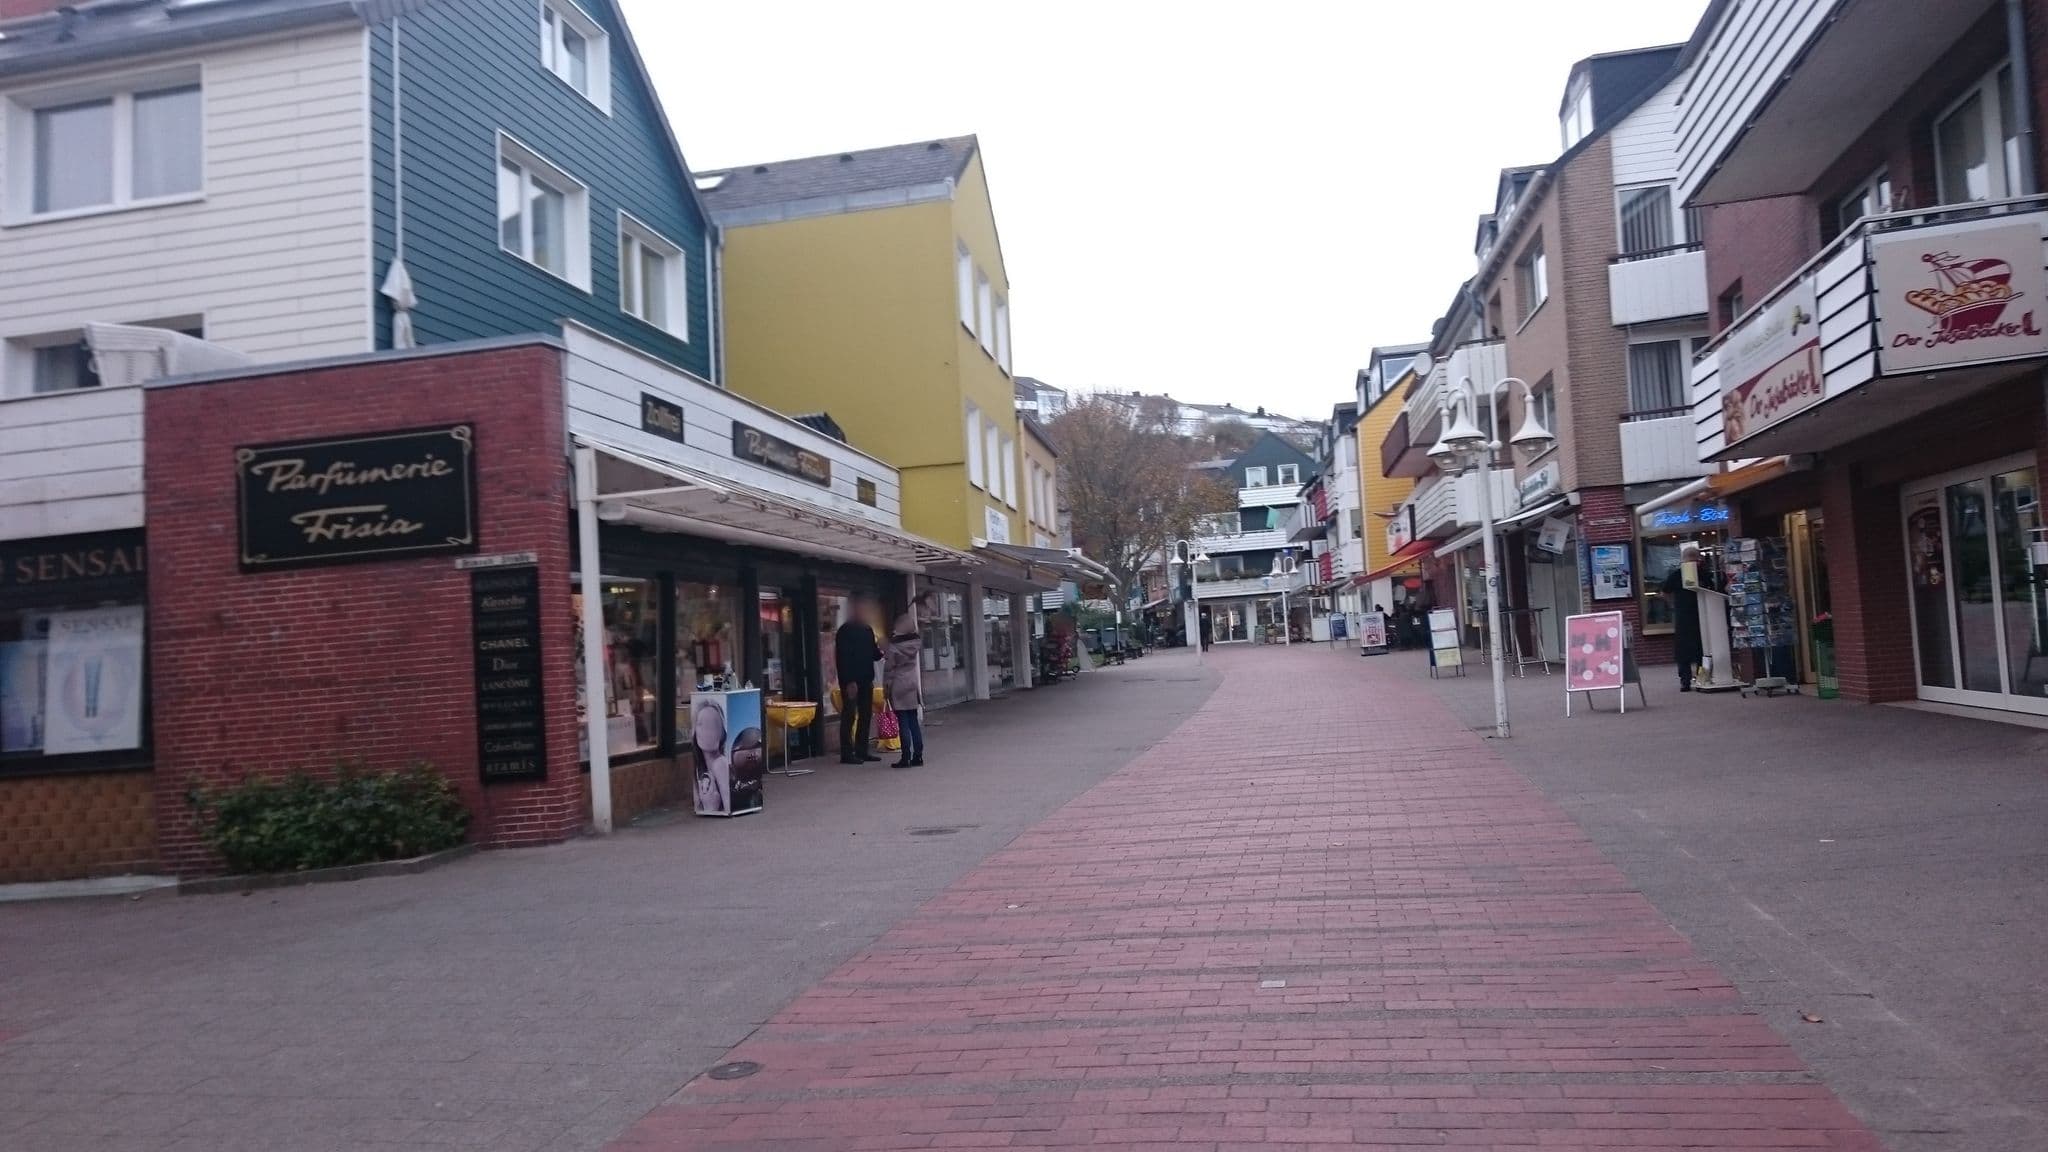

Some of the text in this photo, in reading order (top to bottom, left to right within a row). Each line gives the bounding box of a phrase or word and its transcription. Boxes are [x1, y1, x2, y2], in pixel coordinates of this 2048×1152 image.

[1892, 333, 1922, 348] Der
[251, 453, 454, 495] Parfümerie
[291, 504, 424, 543] Frisia
[16, 545, 145, 584] SENSAI
[480, 637, 529, 650] CHANEL
